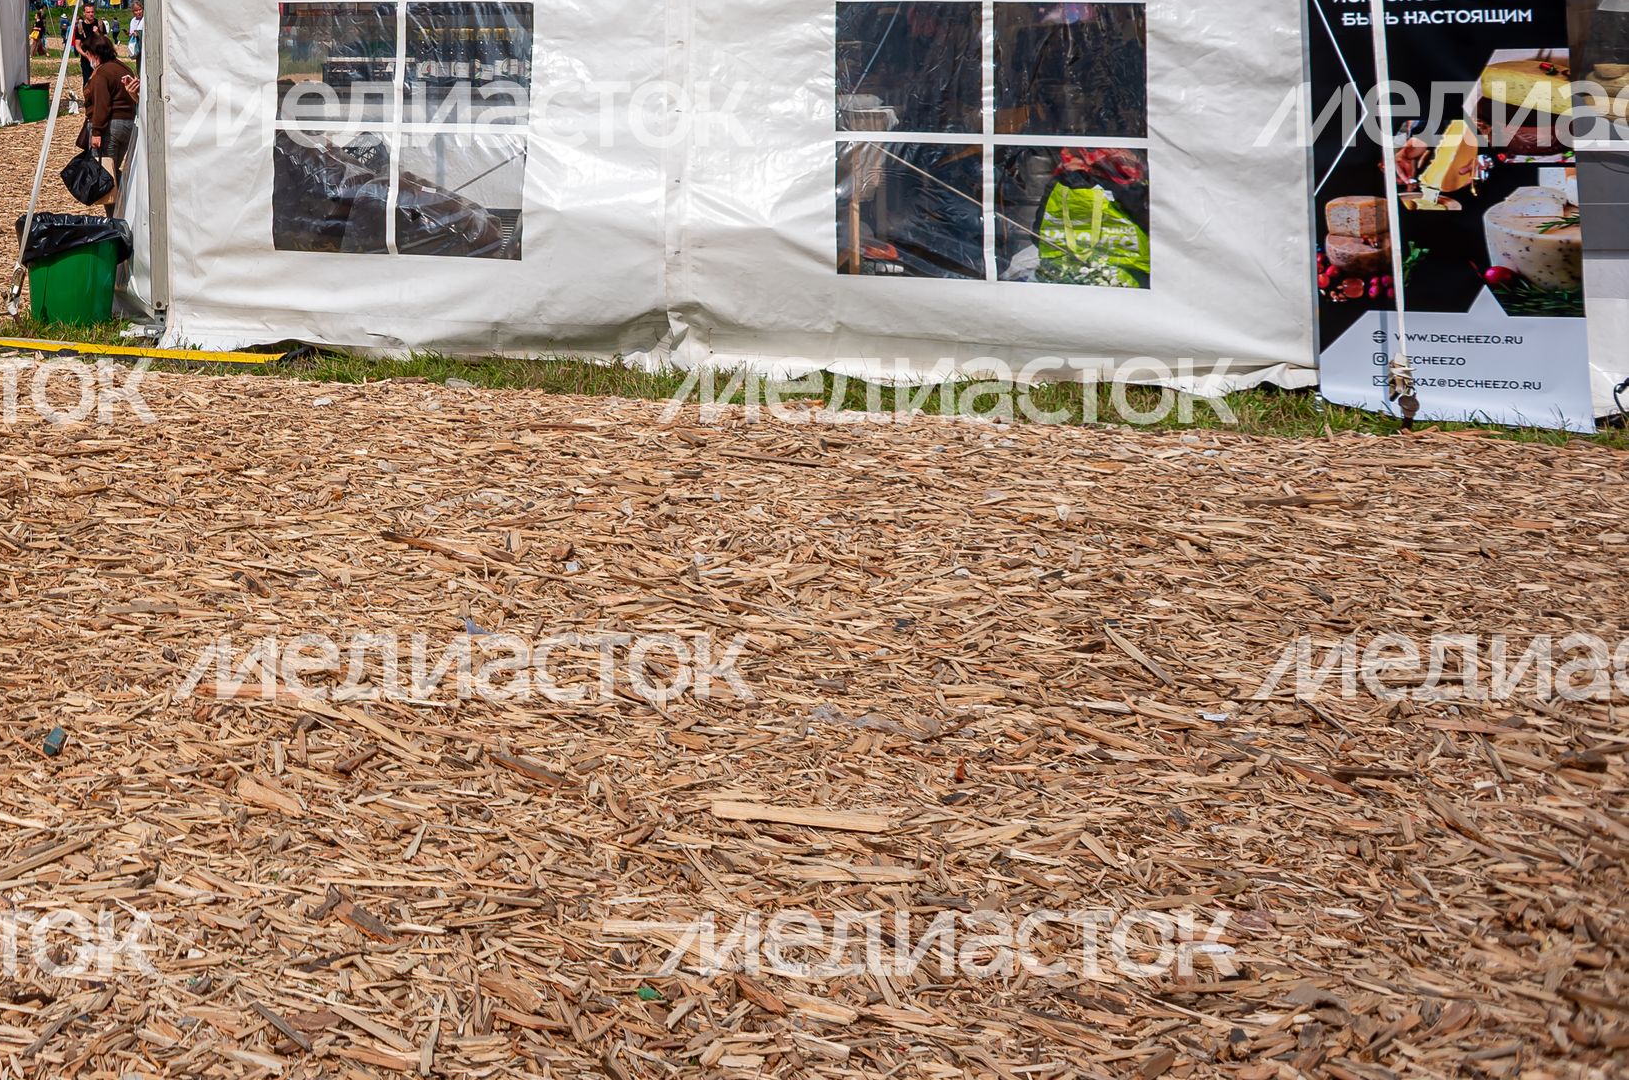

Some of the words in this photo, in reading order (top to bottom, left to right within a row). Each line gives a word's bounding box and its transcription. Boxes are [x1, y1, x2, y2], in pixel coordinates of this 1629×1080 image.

[1341, 11, 1399, 26] БЫЬ
[1403, 9, 1533, 24] НАСТОЯЩИМ
[1406, 355, 1466, 366] ECHEEZO
[1412, 378, 1542, 391] KAZ@DECHEEZO.RU
